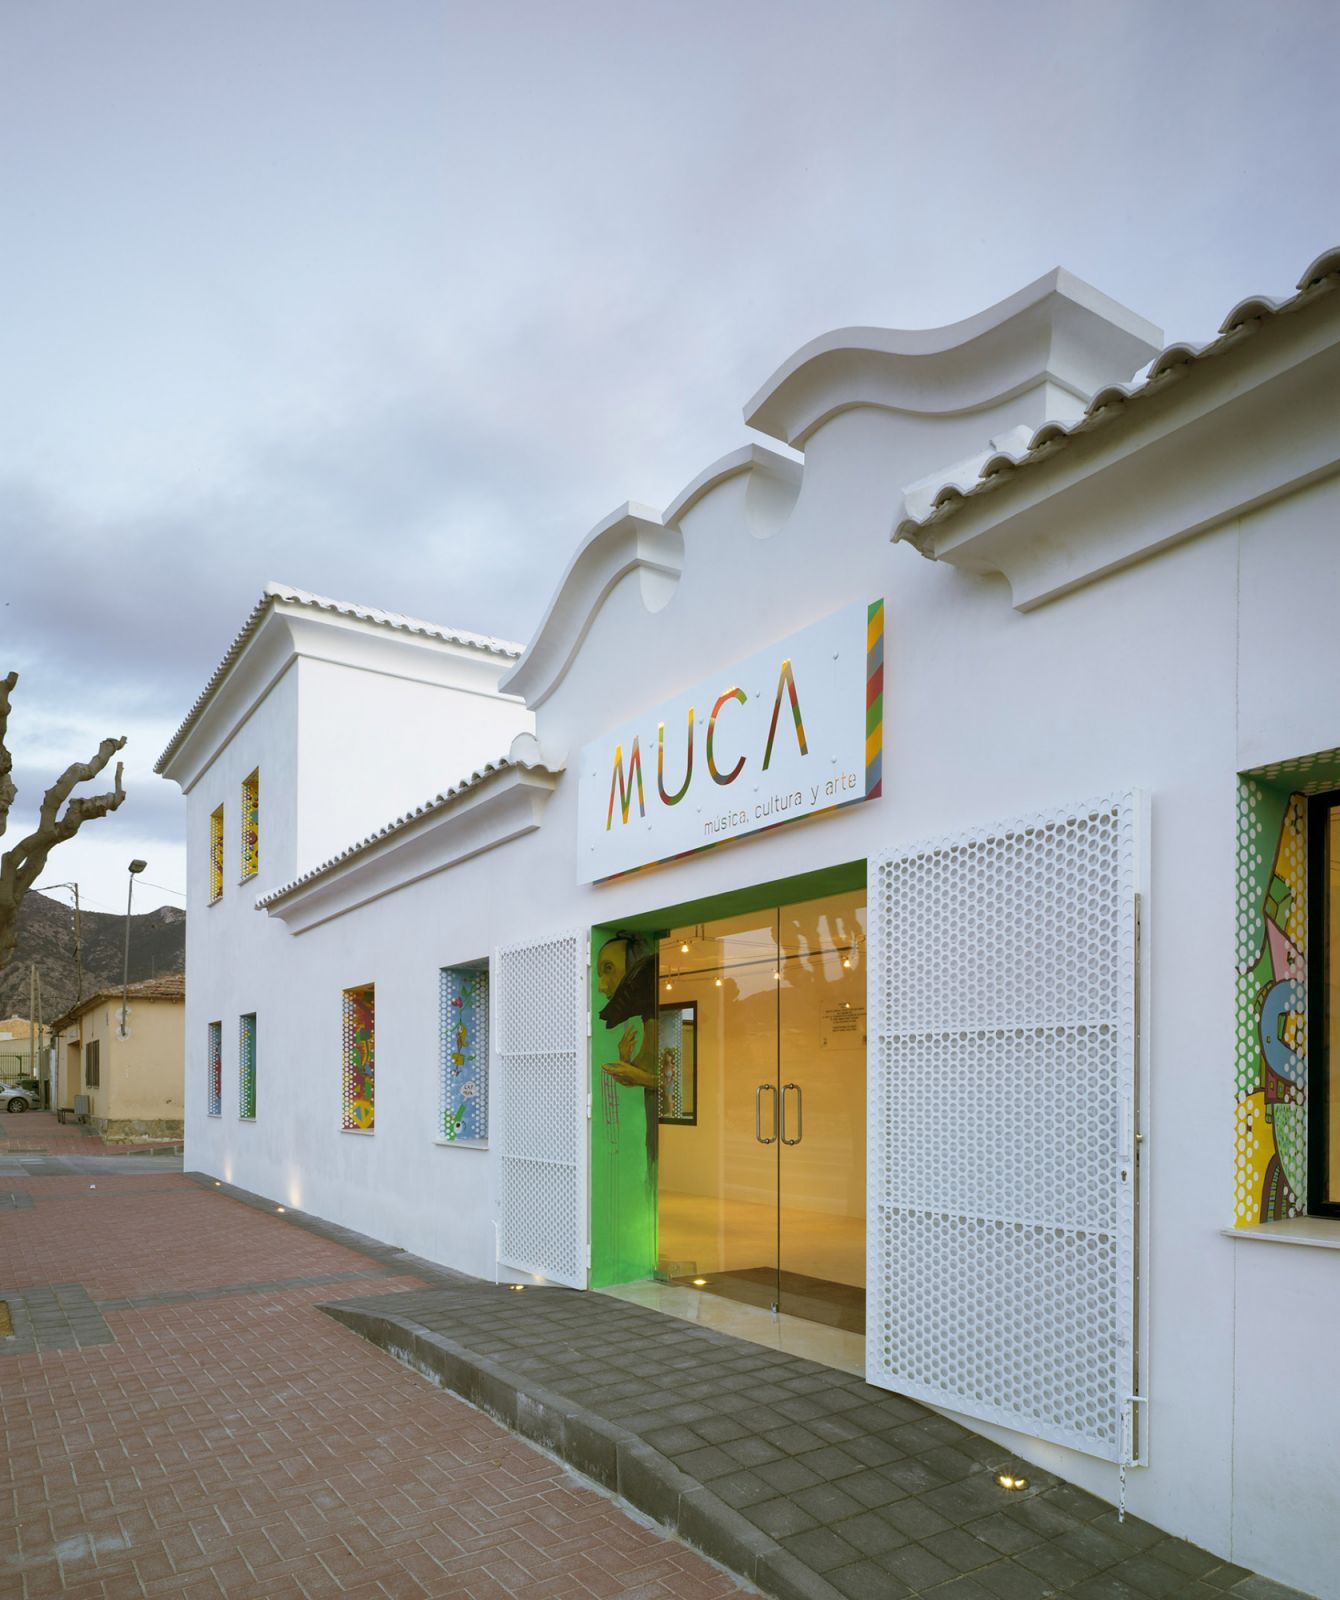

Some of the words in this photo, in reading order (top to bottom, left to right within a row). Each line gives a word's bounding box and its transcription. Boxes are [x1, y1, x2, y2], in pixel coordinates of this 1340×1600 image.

[606, 658, 809, 831] MUCA
[754, 791, 802, 819] cultura
[811, 784, 819, 806] y
[825, 770, 857, 796] arte
